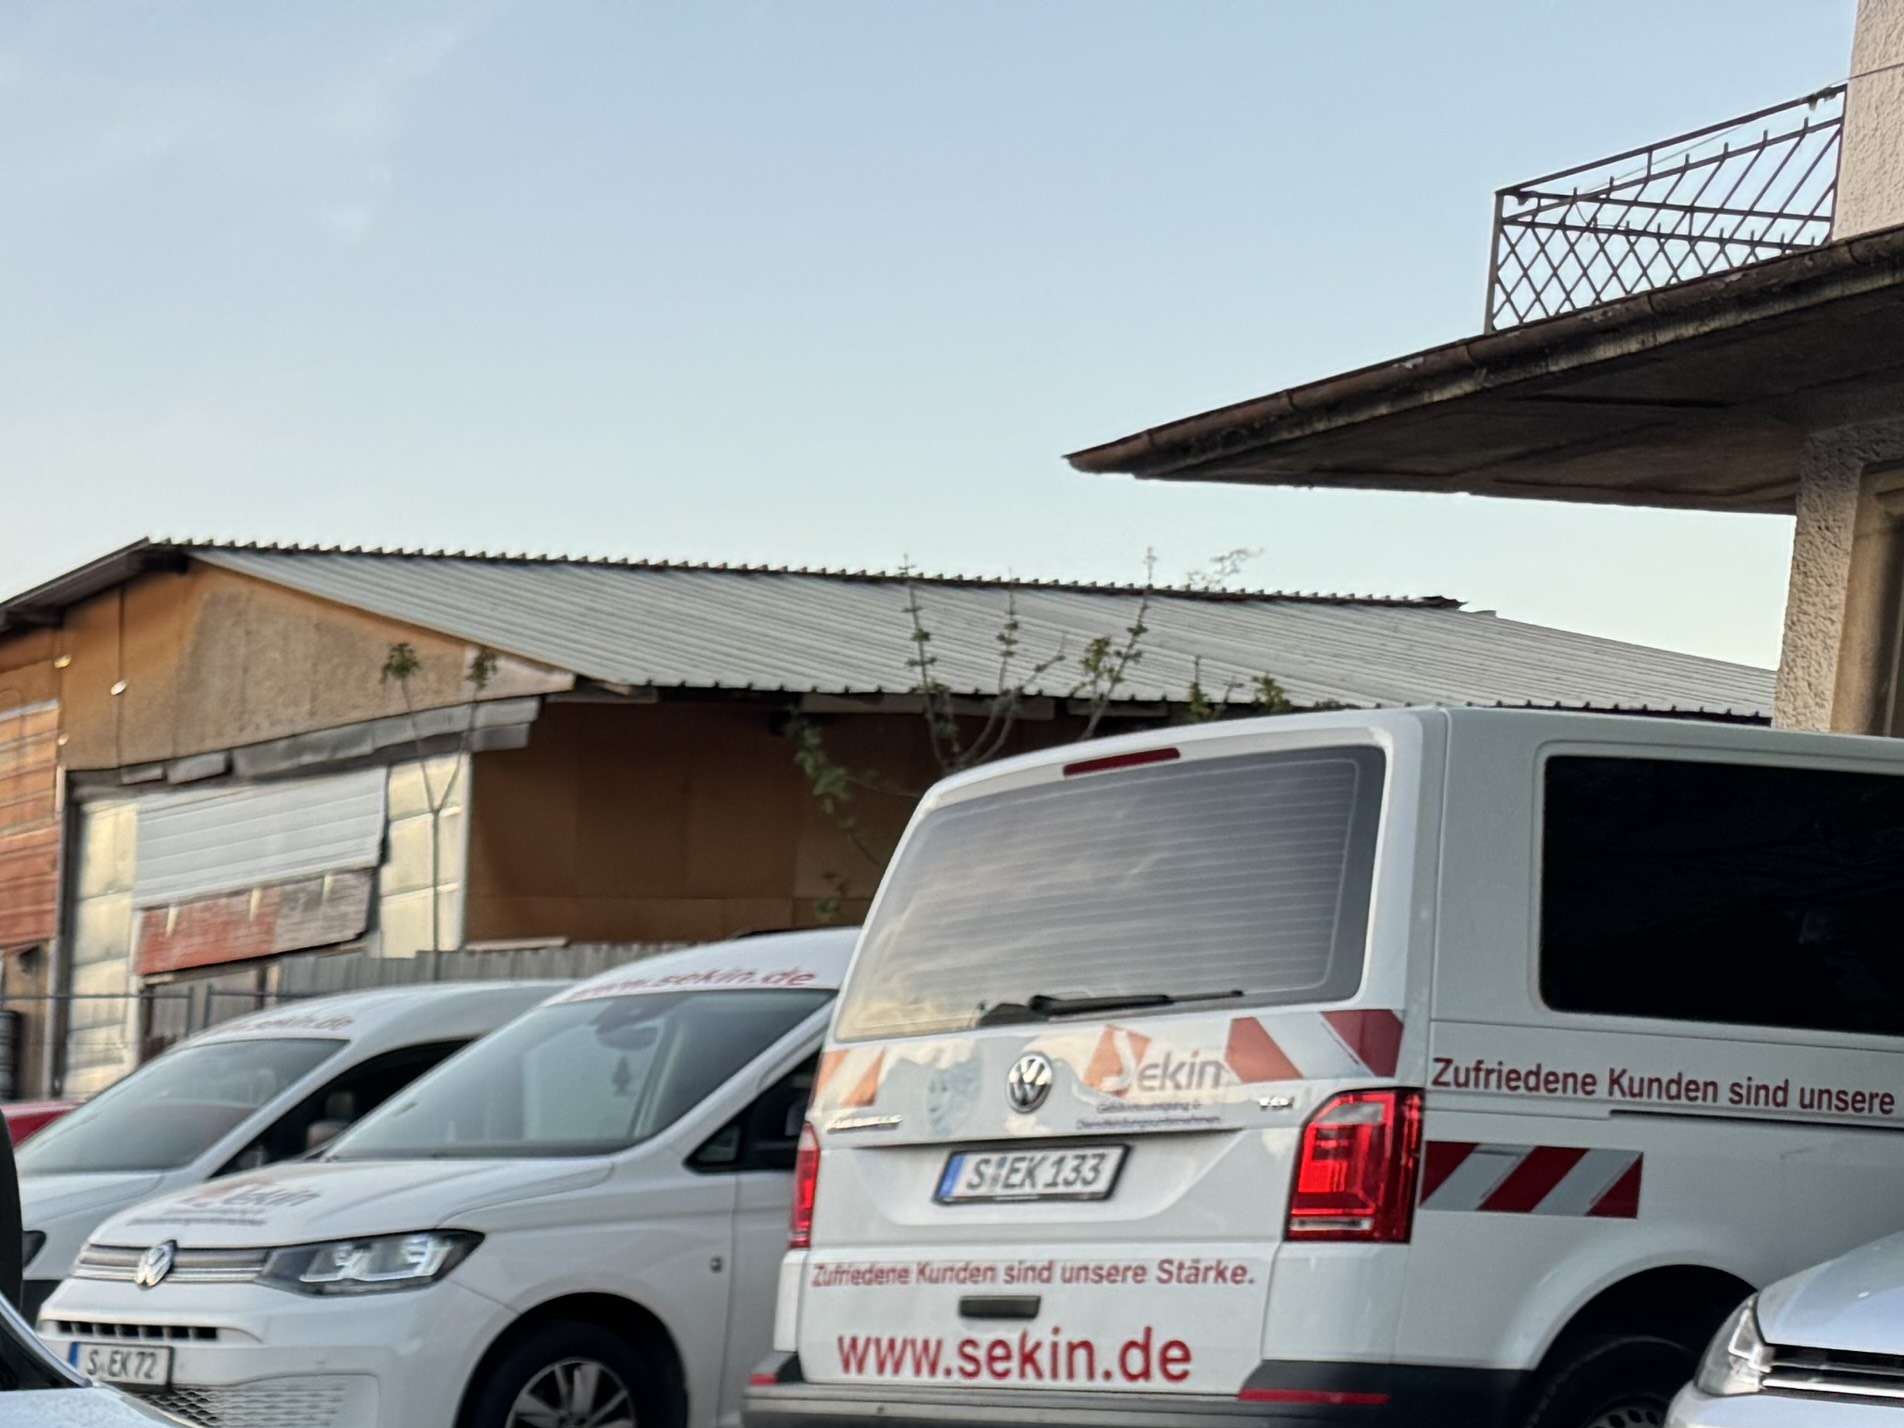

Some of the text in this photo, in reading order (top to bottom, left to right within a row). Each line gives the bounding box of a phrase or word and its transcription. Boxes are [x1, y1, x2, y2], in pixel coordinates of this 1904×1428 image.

[1094, 1024, 1225, 1095] Sekin
[1431, 1056, 1896, 1116] Zufriedene Kunden sind unsere
[1043, 1153, 1107, 1187] 133
[812, 1258, 1256, 1287] Zufriedene Kunden sind unsere Stärke.
[134, 1351, 156, 1379] 72
[836, 1326, 1192, 1383] www.sekin.de
